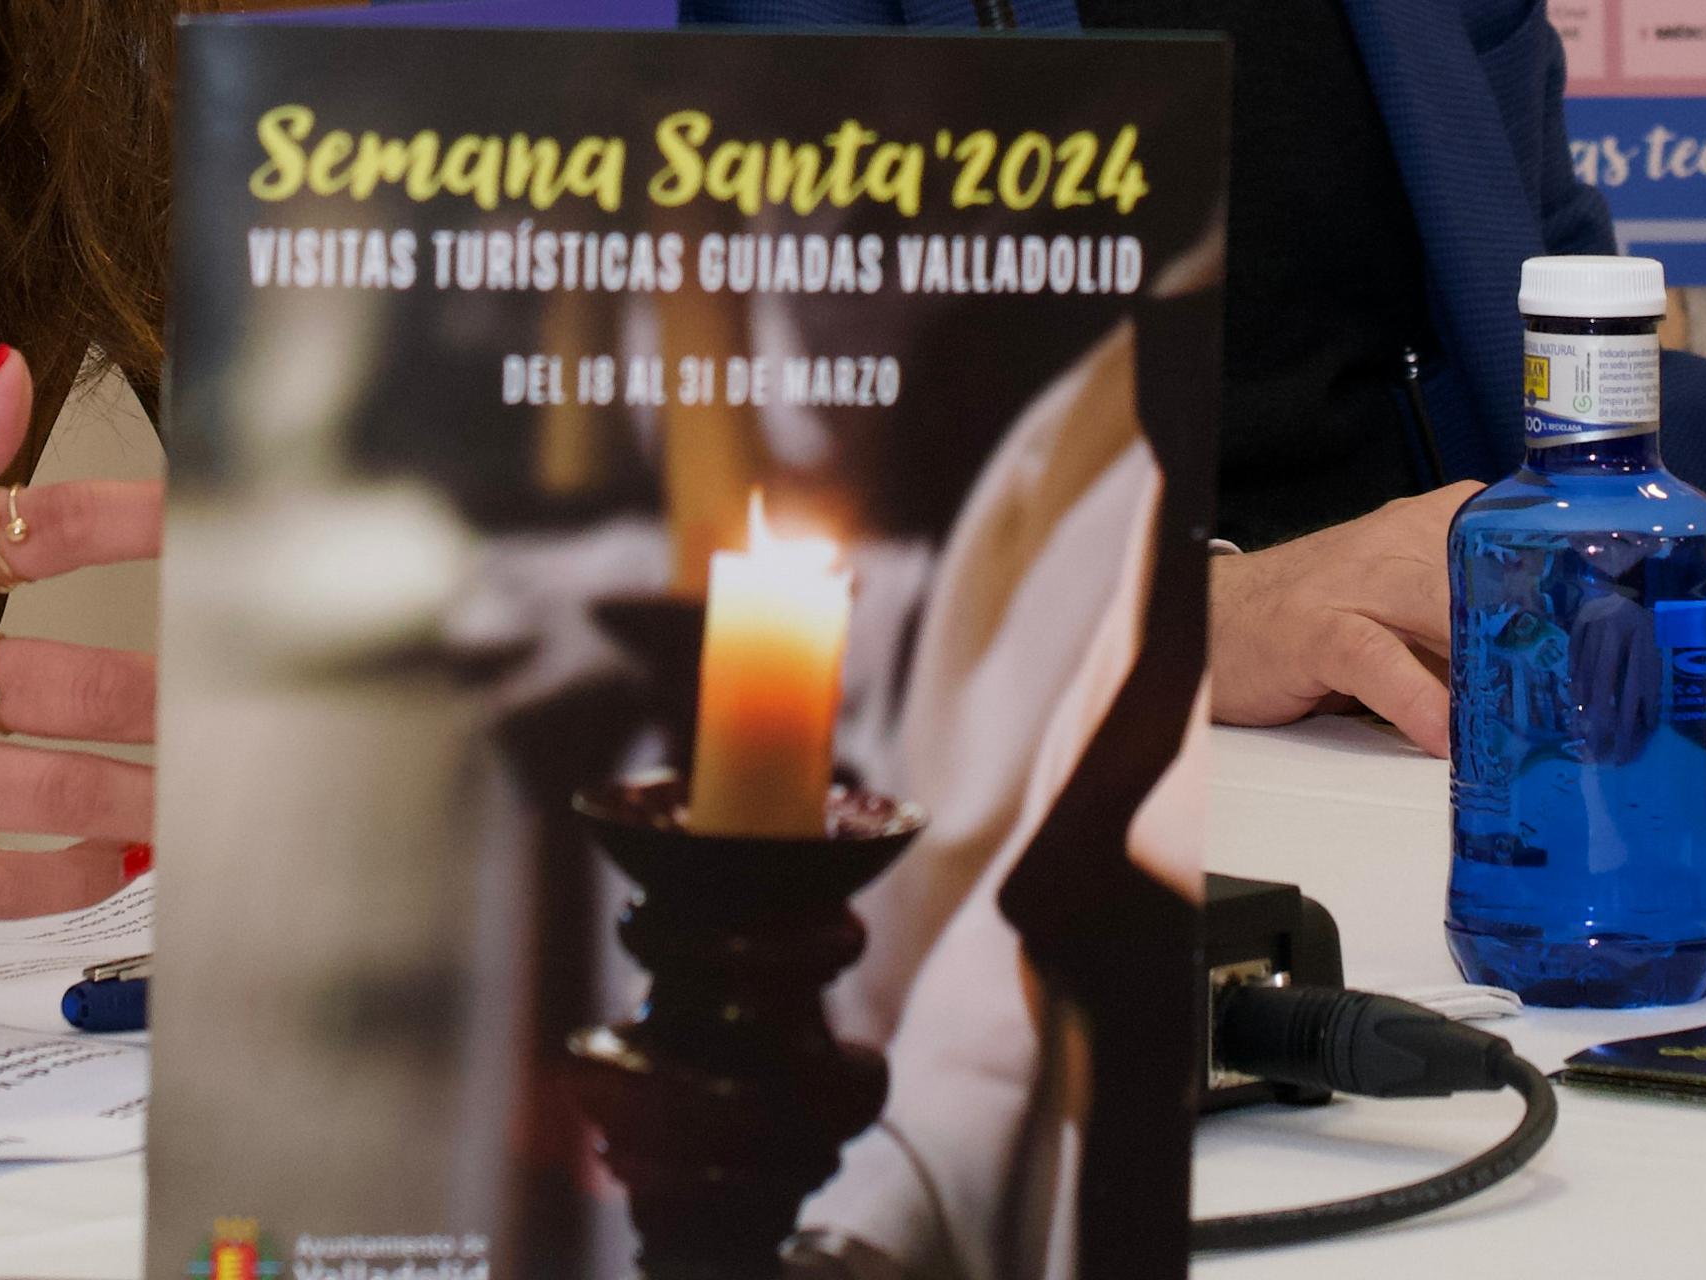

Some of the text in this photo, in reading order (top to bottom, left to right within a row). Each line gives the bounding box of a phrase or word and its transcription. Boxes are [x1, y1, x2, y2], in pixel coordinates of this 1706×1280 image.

[248, 103, 1151, 217] Semana Santa'2024
[248, 219, 1143, 294] VISITAS TURÍSTICAS GUIADAS VALLADOLID
[502, 354, 900, 407] DEL 18 AL 31 DE MARZO
[296, 1233, 489, 1258] Ayuntamiento de
